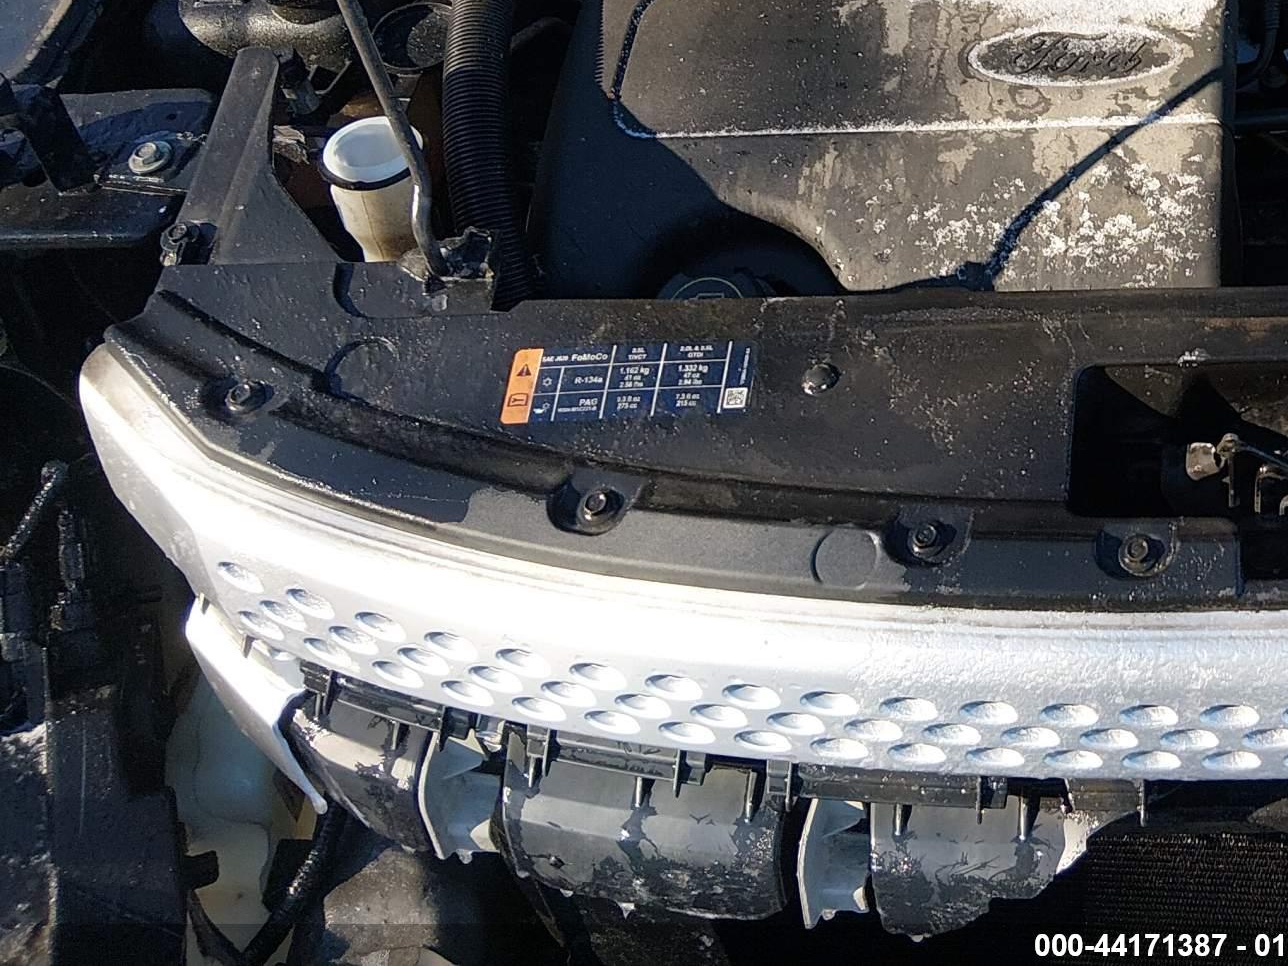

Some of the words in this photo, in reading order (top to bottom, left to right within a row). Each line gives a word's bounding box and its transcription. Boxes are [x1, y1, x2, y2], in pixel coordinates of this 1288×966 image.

[1009, 30, 1146, 74] Ford
[571, 352, 608, 362] FoMoCo
[640, 366, 650, 376] kg
[698, 364, 708, 373] kg
[574, 376, 603, 384] R-134a
[578, 398, 598, 406] PAG
